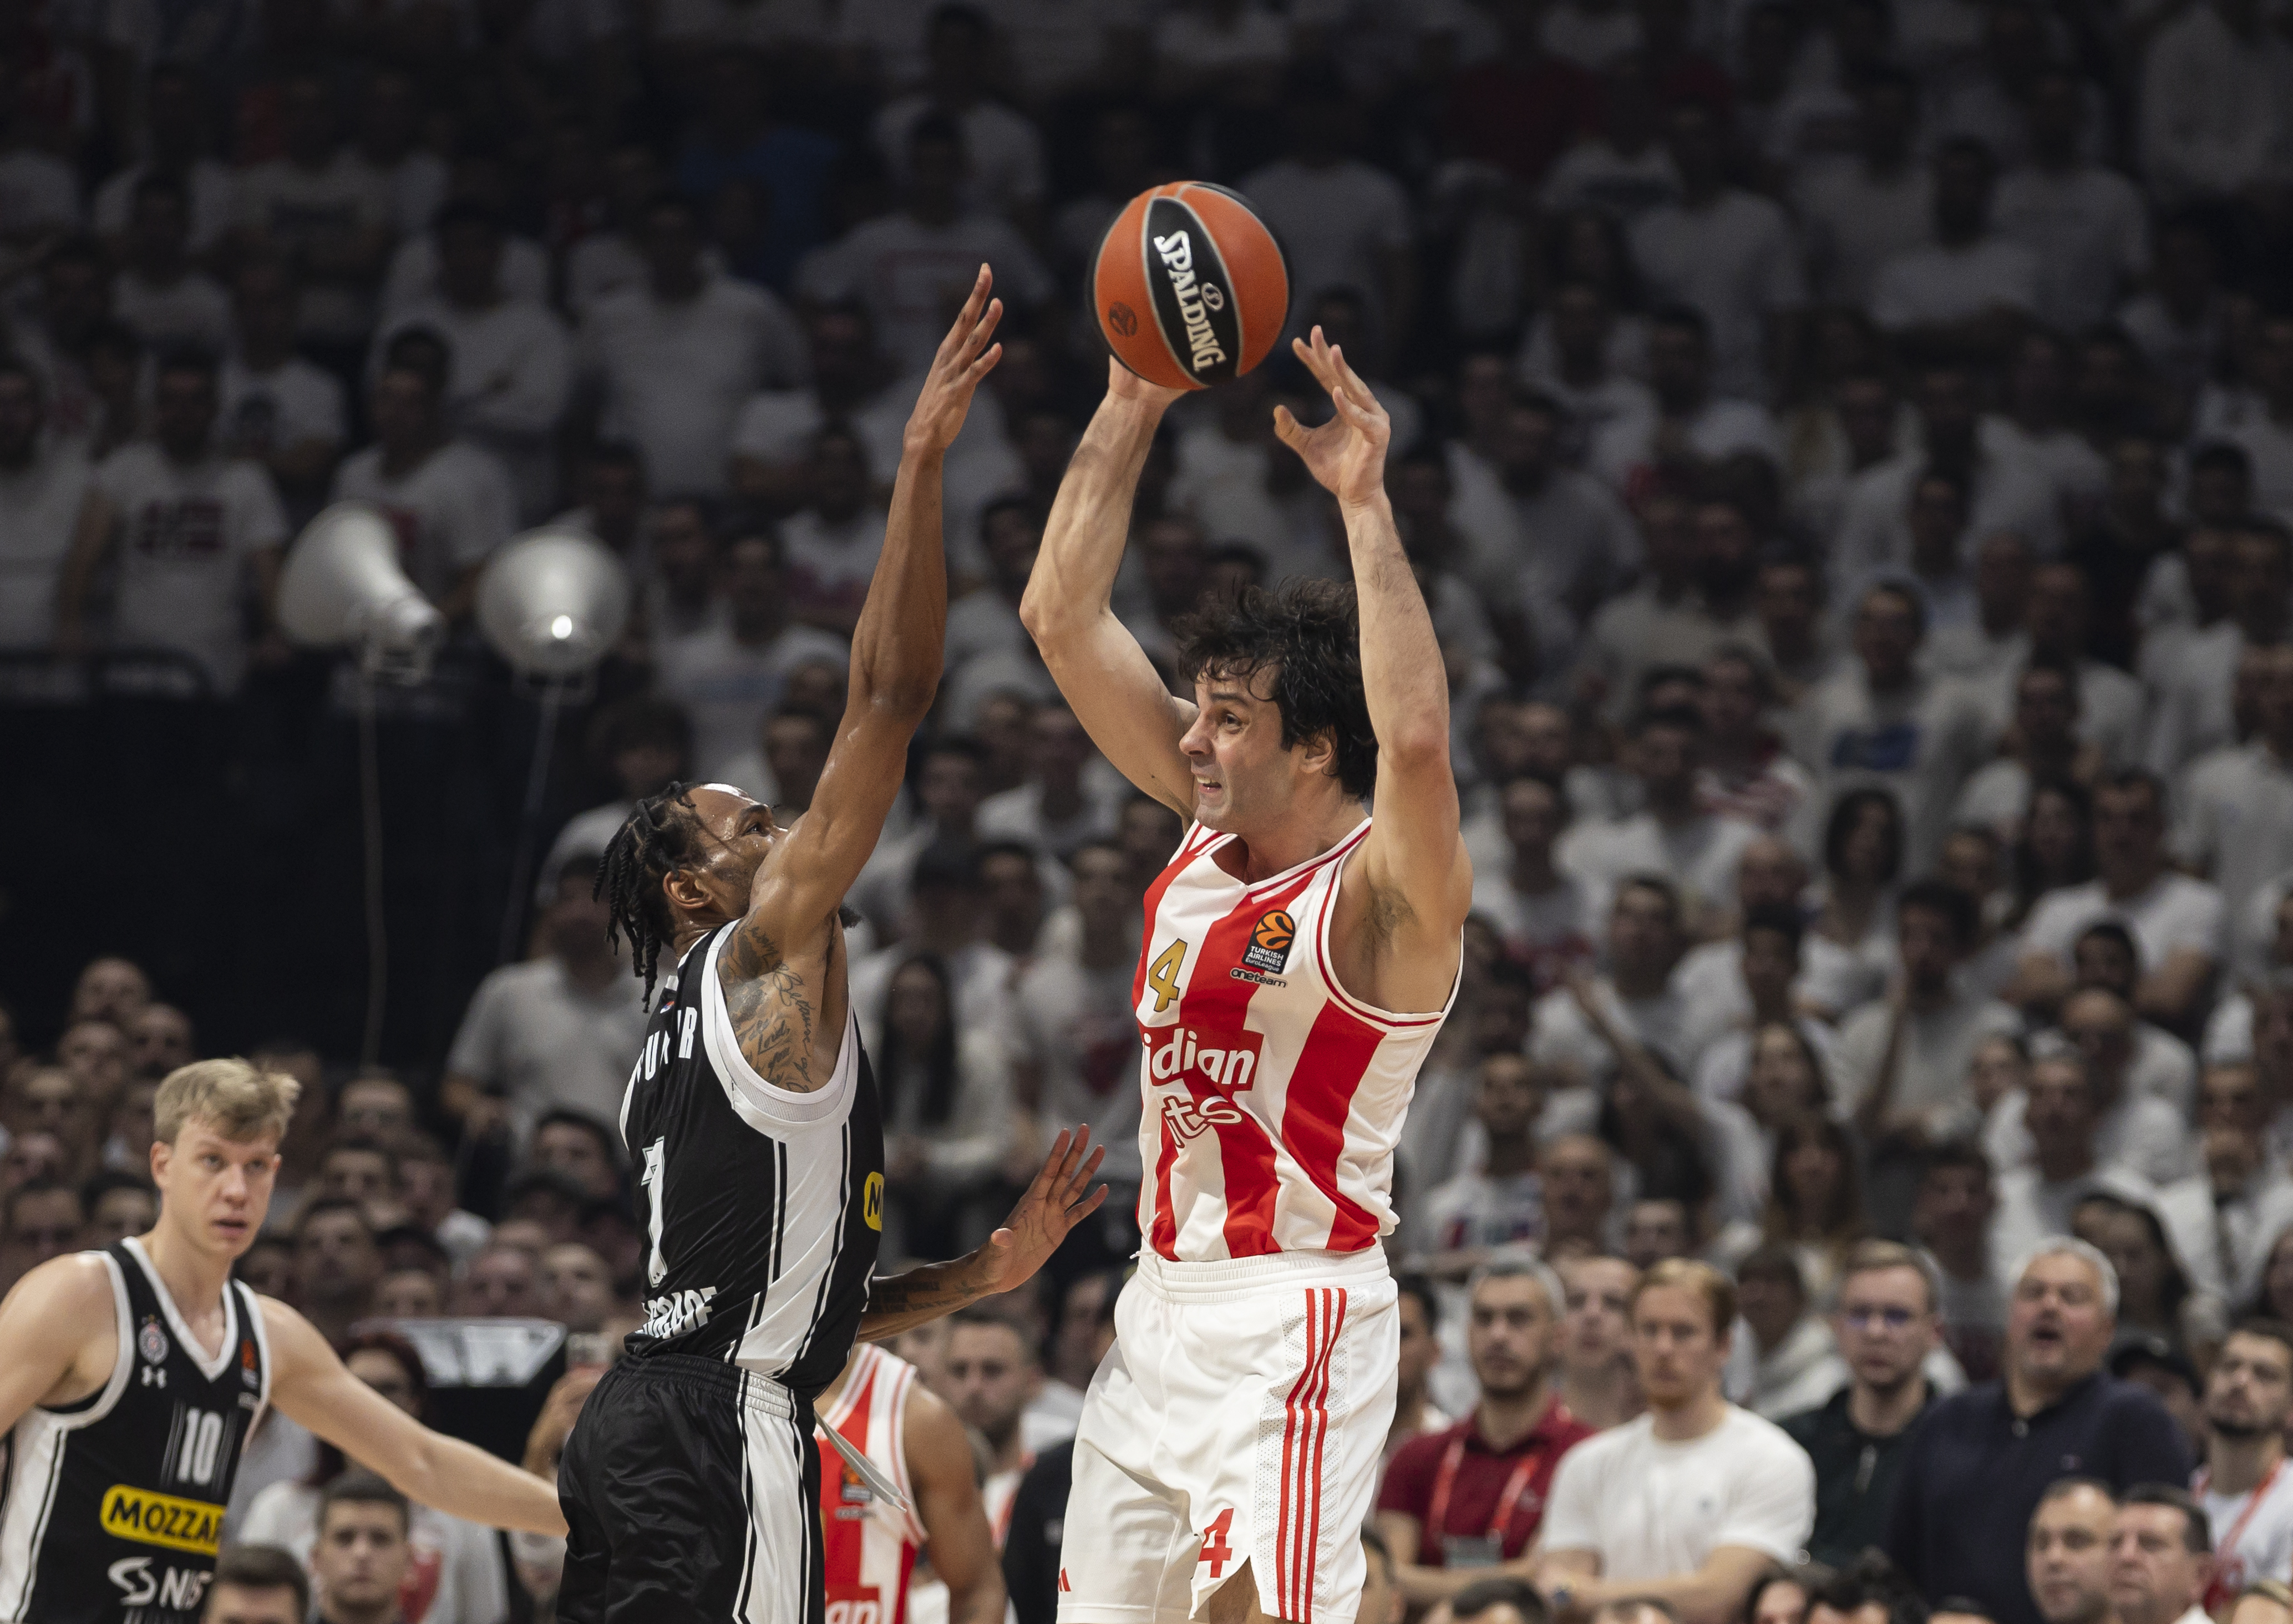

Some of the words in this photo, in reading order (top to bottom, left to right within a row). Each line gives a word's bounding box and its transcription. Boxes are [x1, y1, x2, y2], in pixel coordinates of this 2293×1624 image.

[1153, 230, 1227, 373] SPALDING
[1149, 938, 1188, 1012] 4
[1245, 957, 1280, 971] EuroLeague
[1247, 952, 1282, 967] AIRLINES
[1250, 946, 1284, 960] TURKISH
[1231, 968, 1287, 988] oneteam
[177, 1407, 222, 1486] 10
[1198, 1508, 1234, 1578] 4
